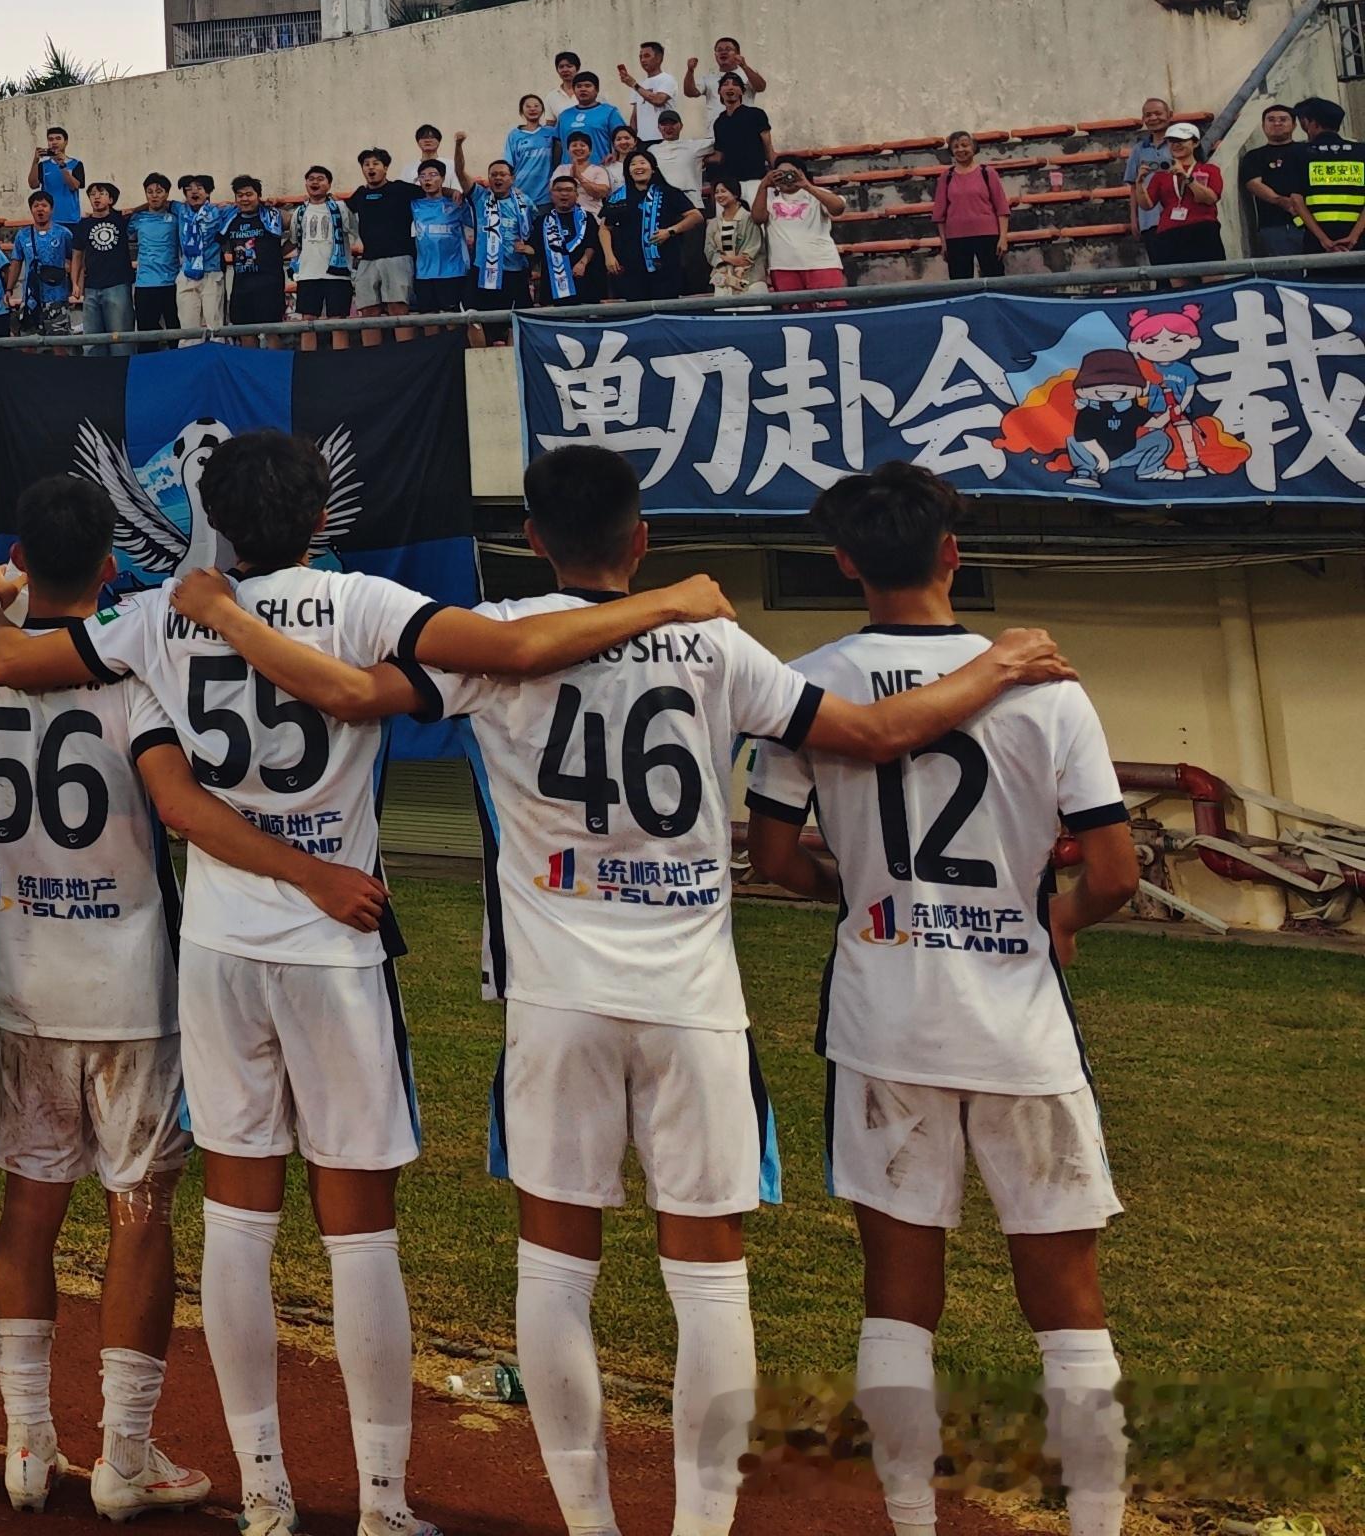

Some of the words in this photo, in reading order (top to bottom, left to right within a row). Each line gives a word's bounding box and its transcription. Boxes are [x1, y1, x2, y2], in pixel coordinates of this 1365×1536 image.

[536, 315, 1017, 496] 单刀赴会
[631, 632, 714, 665] SH.X.
[187, 654, 330, 795] 55
[536, 682, 704, 839] 46
[875, 729, 998, 889] 12
[17, 874, 118, 902] 统顺地产
[597, 857, 720, 888] 统顺地产
[17, 899, 121, 920] TSLAND
[597, 884, 721, 907] TSLAND
